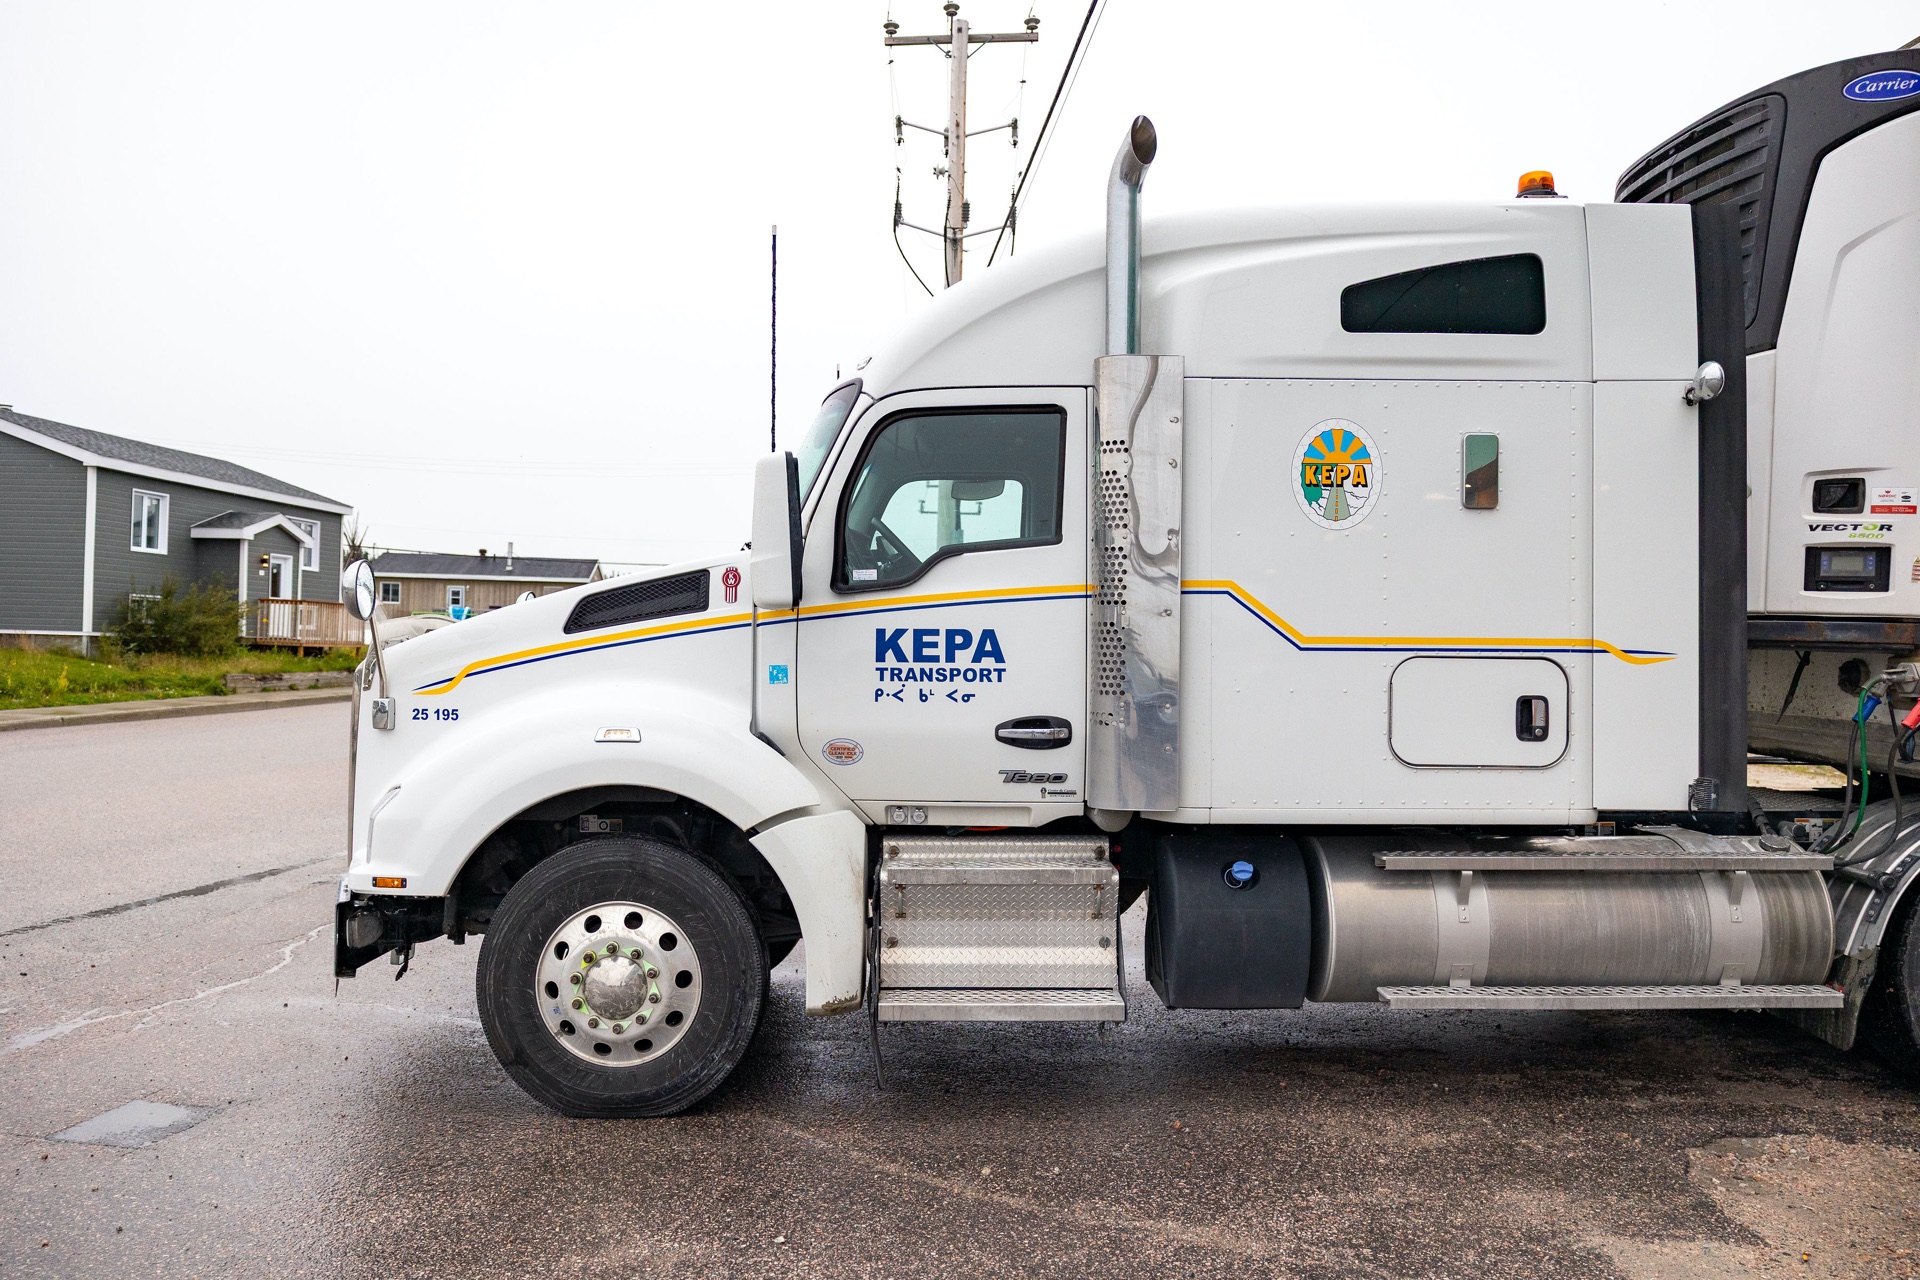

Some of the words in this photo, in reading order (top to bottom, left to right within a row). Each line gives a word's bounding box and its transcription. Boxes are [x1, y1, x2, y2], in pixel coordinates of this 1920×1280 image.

[1854, 78, 1918, 94] Carrier
[1305, 465, 1368, 487] KEPA
[1808, 523, 1893, 531] VECTOR
[875, 628, 1006, 663] KEPA
[875, 667, 1007, 682] TRANSPORT
[412, 708, 429, 720] 25
[433, 708, 459, 721] 195
[998, 769, 1068, 783] T880
